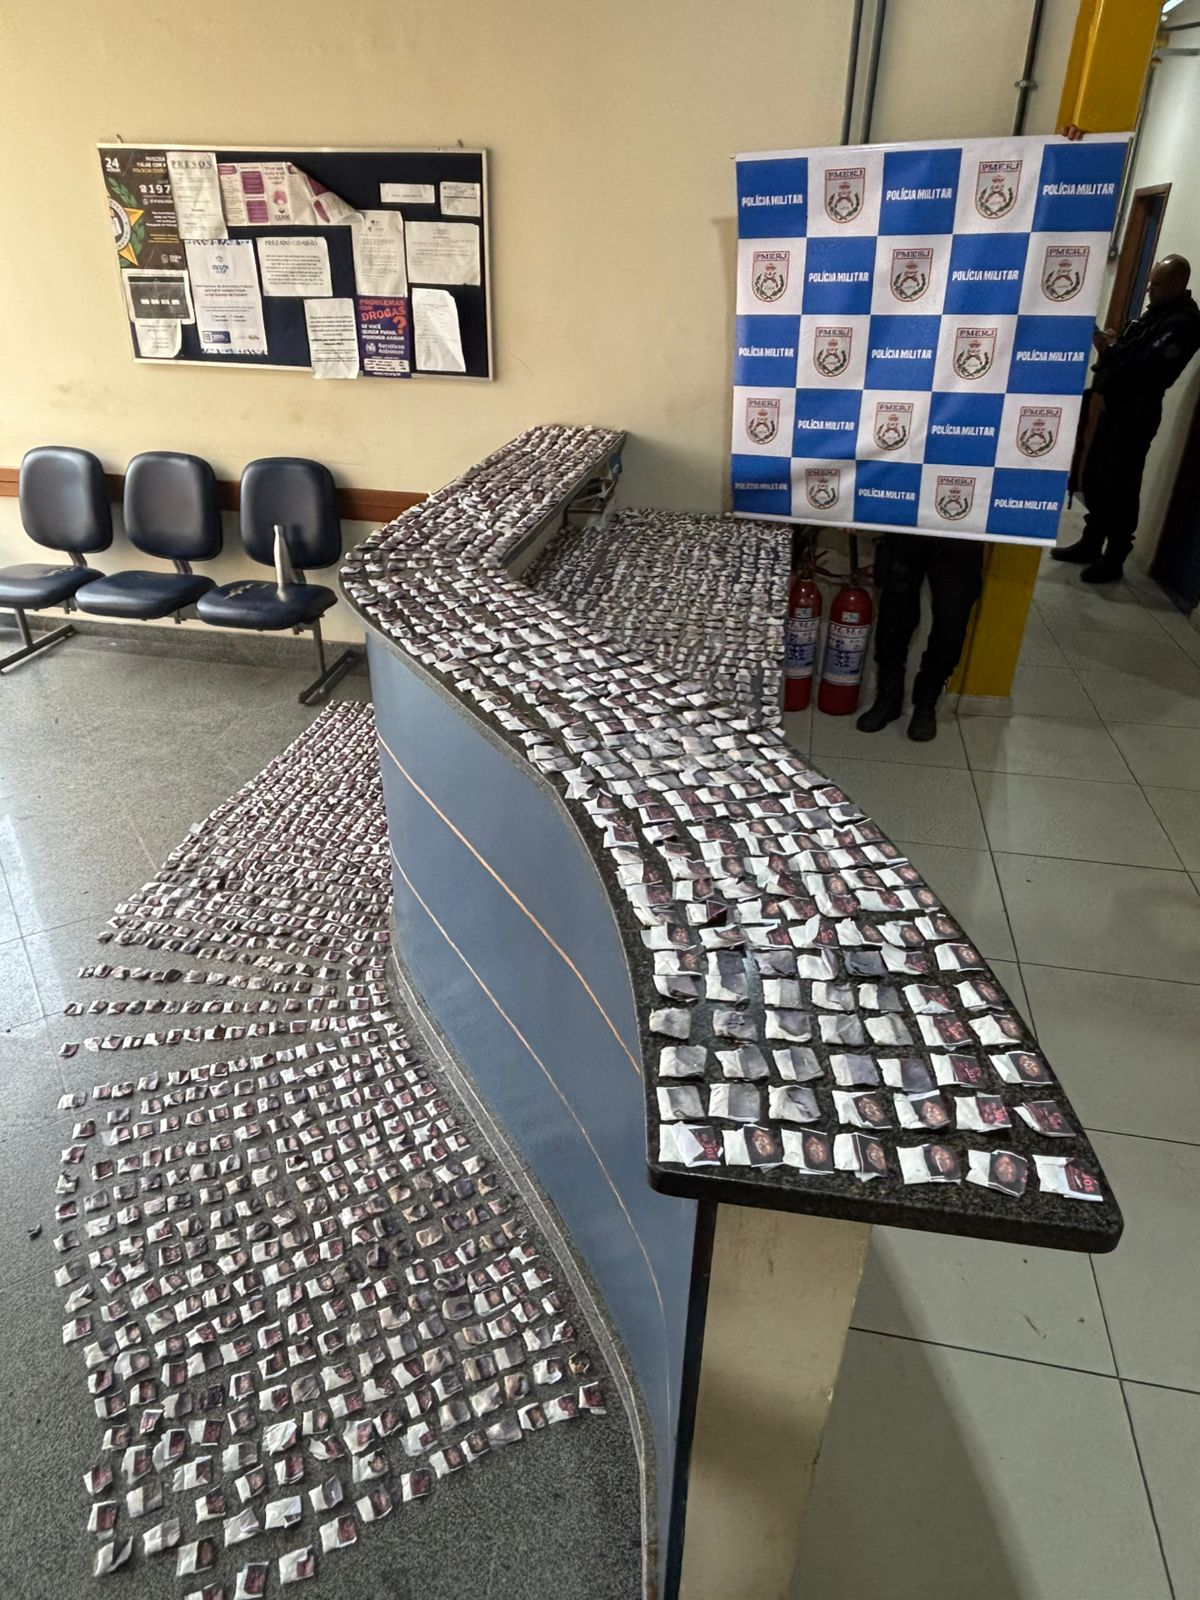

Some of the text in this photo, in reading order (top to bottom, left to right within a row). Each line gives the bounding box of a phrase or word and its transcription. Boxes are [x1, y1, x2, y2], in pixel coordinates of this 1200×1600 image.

[105, 157, 119, 168] 24
[148, 184, 171, 194] 197
[886, 188, 952, 201] POLÍCIA MILITAR
[1042, 182, 1115, 196] POLÍCIA MILITAR
[808, 270, 869, 282] POLÍCIA MILITAR
[952, 268, 1019, 281] POLÍCIA MILITAR
[361, 307, 406, 321] DROGAS
[739, 345, 794, 357] POLÍCIA MILITAR
[872, 346, 932, 359] POLÍCIA MILITAR
[1016, 349, 1085, 362] POLÍCIA MILITAR
[798, 418, 855, 431] POLÍCIA MILITAR
[931, 423, 995, 436] POLÍCIA MILITAR
[858, 487, 916, 501] POLÍCIA MILITAR
[993, 497, 1059, 511] POLÍCIA MILITAR
